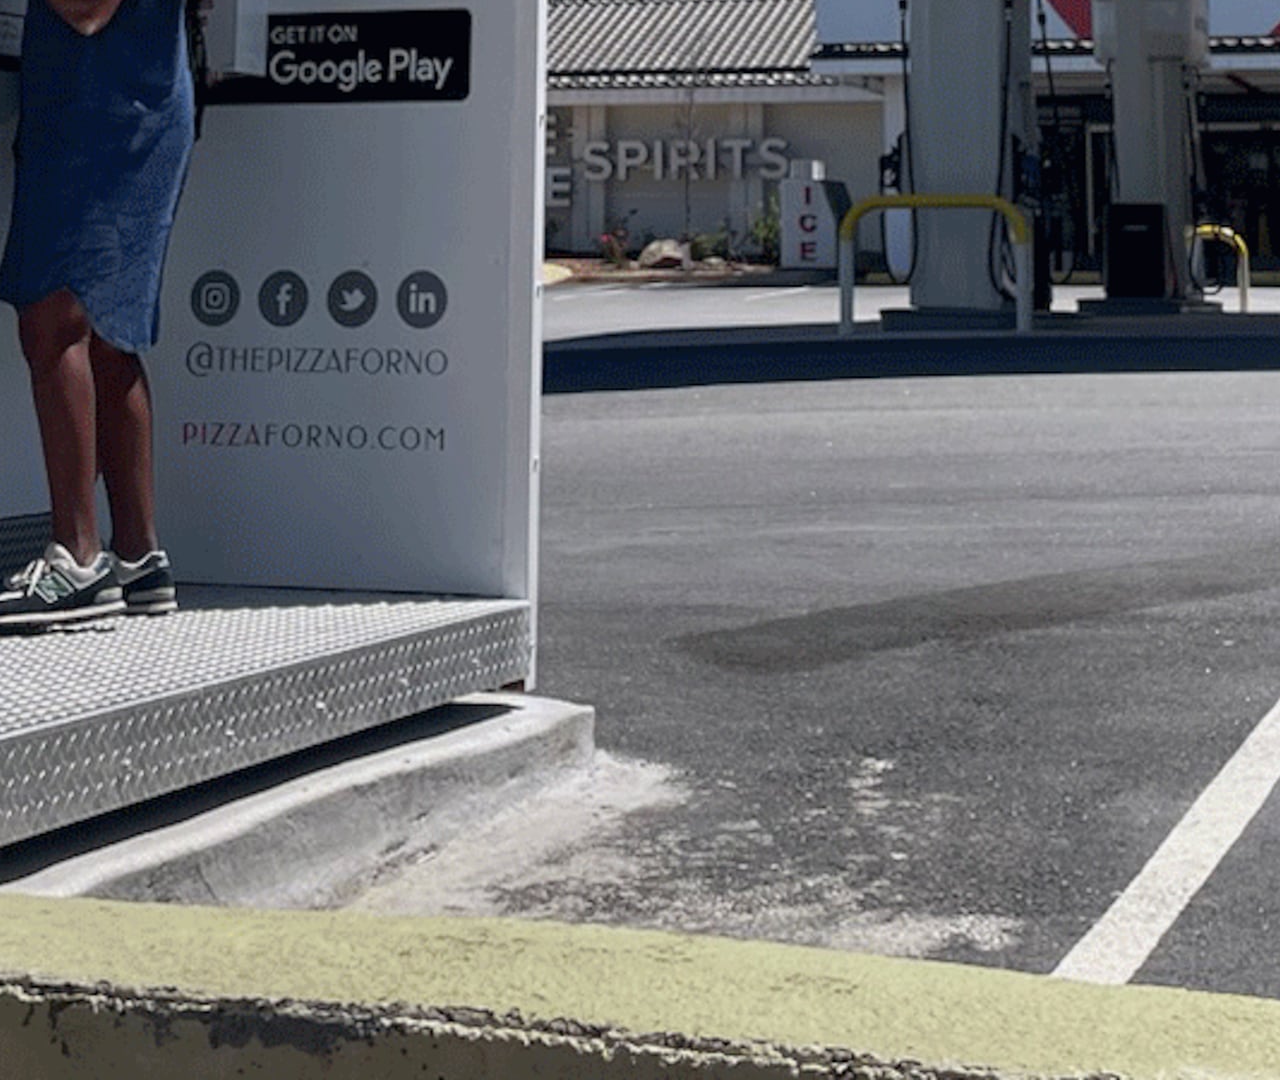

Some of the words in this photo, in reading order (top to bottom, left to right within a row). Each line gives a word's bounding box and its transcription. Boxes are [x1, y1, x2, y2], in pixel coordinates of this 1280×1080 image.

[270, 26, 306, 44] GET
[309, 25, 324, 42] IT
[327, 24, 358, 43] ON
[270, 50, 382, 92] Google
[388, 48, 453, 90] Play
[582, 137, 790, 182] SPIRITS
[798, 186, 818, 261] ICE
[186, 341, 449, 377] @THEPIZZAFORNO
[182, 421, 446, 452] PIZZAFORNO.COM
